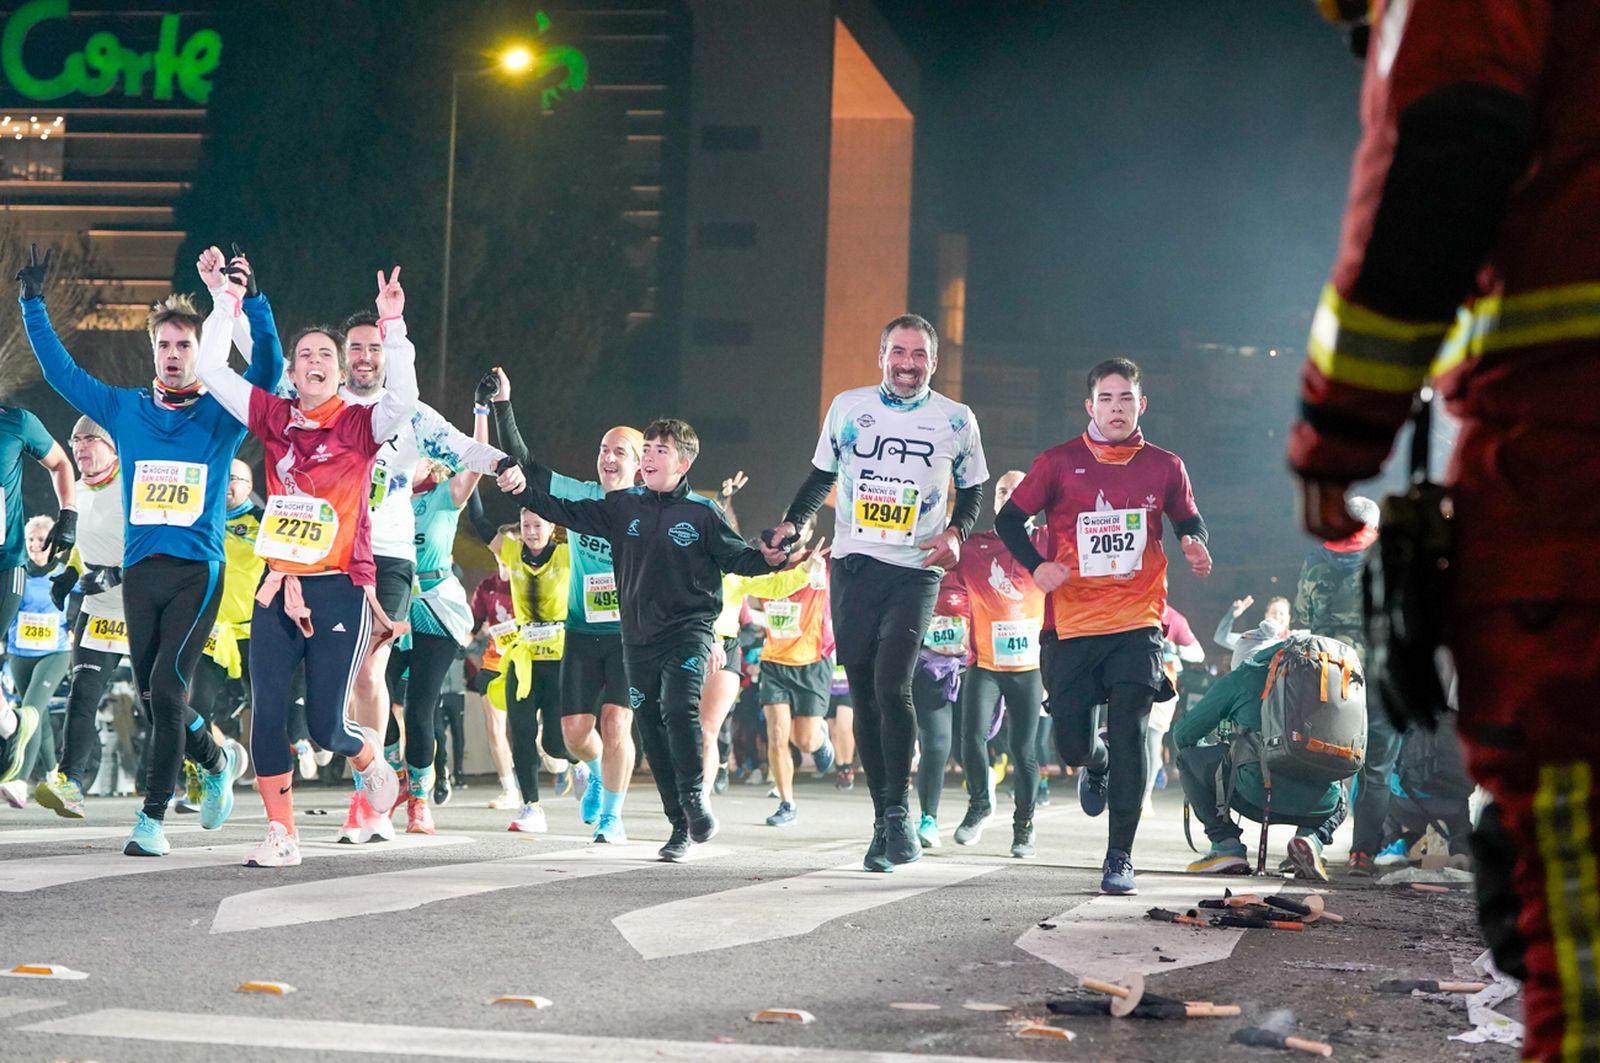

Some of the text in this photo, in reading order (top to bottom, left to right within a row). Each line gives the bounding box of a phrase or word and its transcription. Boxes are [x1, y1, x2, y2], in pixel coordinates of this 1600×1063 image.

[2, 0, 222, 104] Corte
[853, 435, 934, 467] JAR
[149, 467, 169, 475] NOCHE
[145, 483, 189, 504] 2276
[868, 487, 887, 495] NOCHE
[284, 503, 304, 511] NOCHE
[862, 502, 911, 524] 12947
[1091, 517, 1111, 525] NOCHE
[275, 518, 322, 541] 2275
[1090, 532, 1135, 554] 2052
[594, 591, 618, 606] 493
[25, 625, 51, 638] 2385
[95, 619, 128, 637] 1344
[933, 628, 955, 643] 640
[1007, 637, 1028, 650] 414
